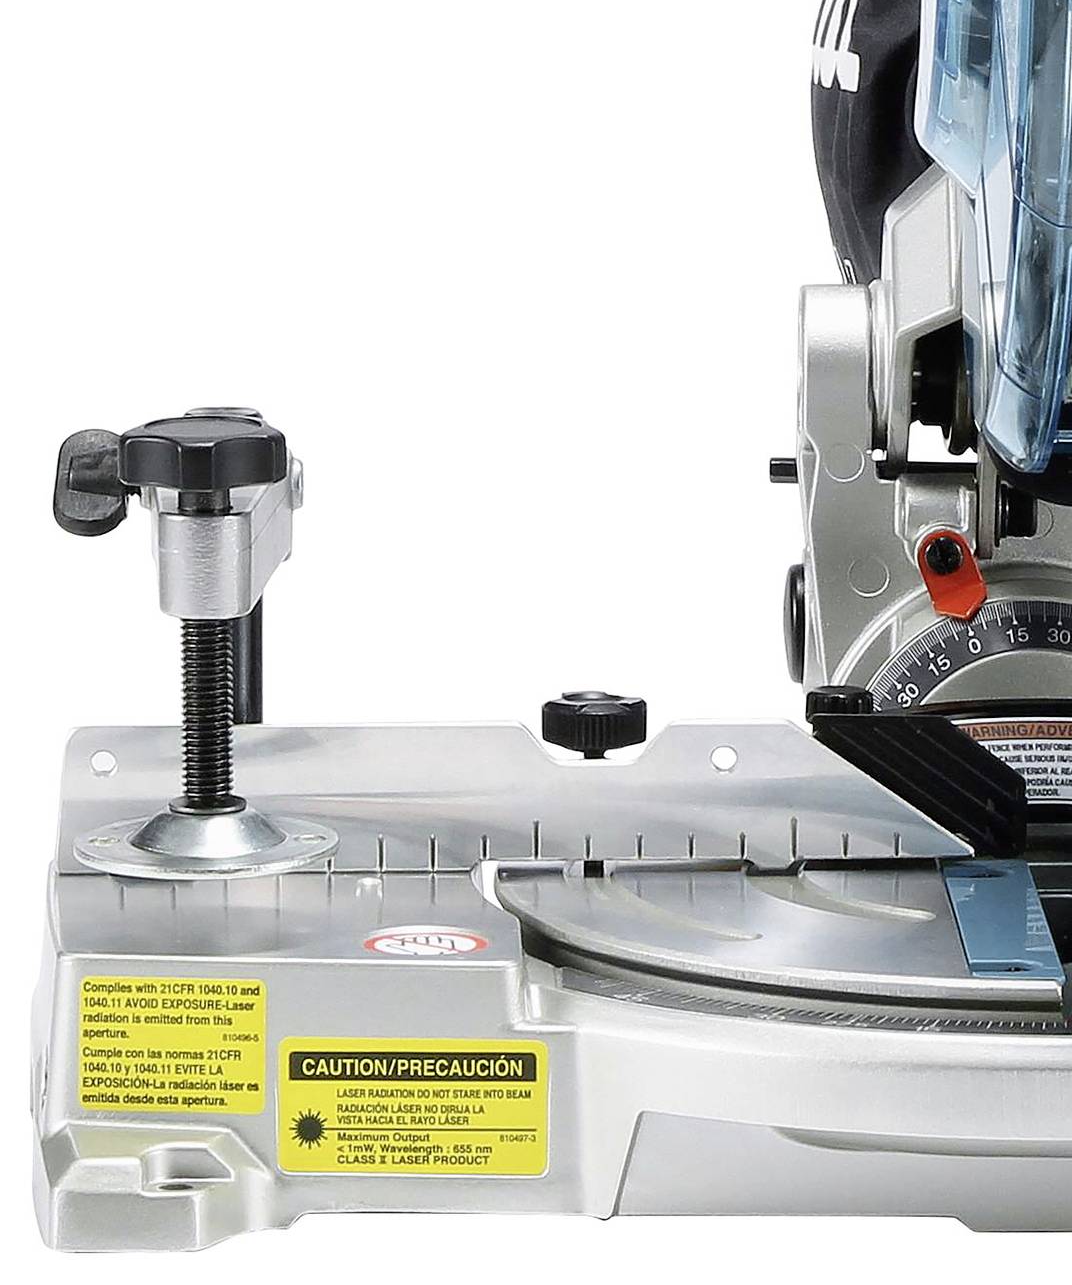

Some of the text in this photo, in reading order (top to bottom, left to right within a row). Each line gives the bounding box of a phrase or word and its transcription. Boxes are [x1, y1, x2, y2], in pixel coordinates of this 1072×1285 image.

[898, 682, 919, 708] 30
[929, 654, 951, 677] 15
[968, 637, 981, 654] 0
[1006, 628, 1029, 643] 15
[1048, 629, 1071, 644] 30
[83, 982, 260, 996] Complies with 21CFR 1040.10 and
[84, 998, 255, 1010] 1040.11 AVOID EXPOSURE-Laser
[83, 1013, 232, 1026] radiation is emitted from this
[83, 1028, 129, 1039] aperture.
[83, 1047, 241, 1060] Cumple con las normas 21CFR
[83, 1063, 223, 1075] 1040.10 y 1040.11 EVITE LA
[302, 1055, 523, 1076] CAUTION/PRECAUCIÓN
[83, 1078, 165, 1089] EXPOSICIÓN-La
[169, 1080, 216, 1090] radiación
[220, 1081, 243, 1091] láser
[82, 1093, 227, 1107] emitida desde esta apertura.
[337, 1089, 531, 1099] LASER RADIATION DO NOT STARE INTO BEAM
[337, 1103, 484, 1114] RADIACIÓN LÁSER NO DIRIJA LA
[337, 1114, 469, 1125] VISTA HACIA EL RAYO LÁSER
[338, 1132, 429, 1143] Maximum Output
[348, 1144, 376, 1154] 1mW,
[380, 1145, 443, 1156] Wavelength
[453, 1145, 471, 1153] 655
[337, 1155, 376, 1164] CLASS
[392, 1156, 429, 1164] LASER
[433, 1156, 489, 1165] PRODUCT
